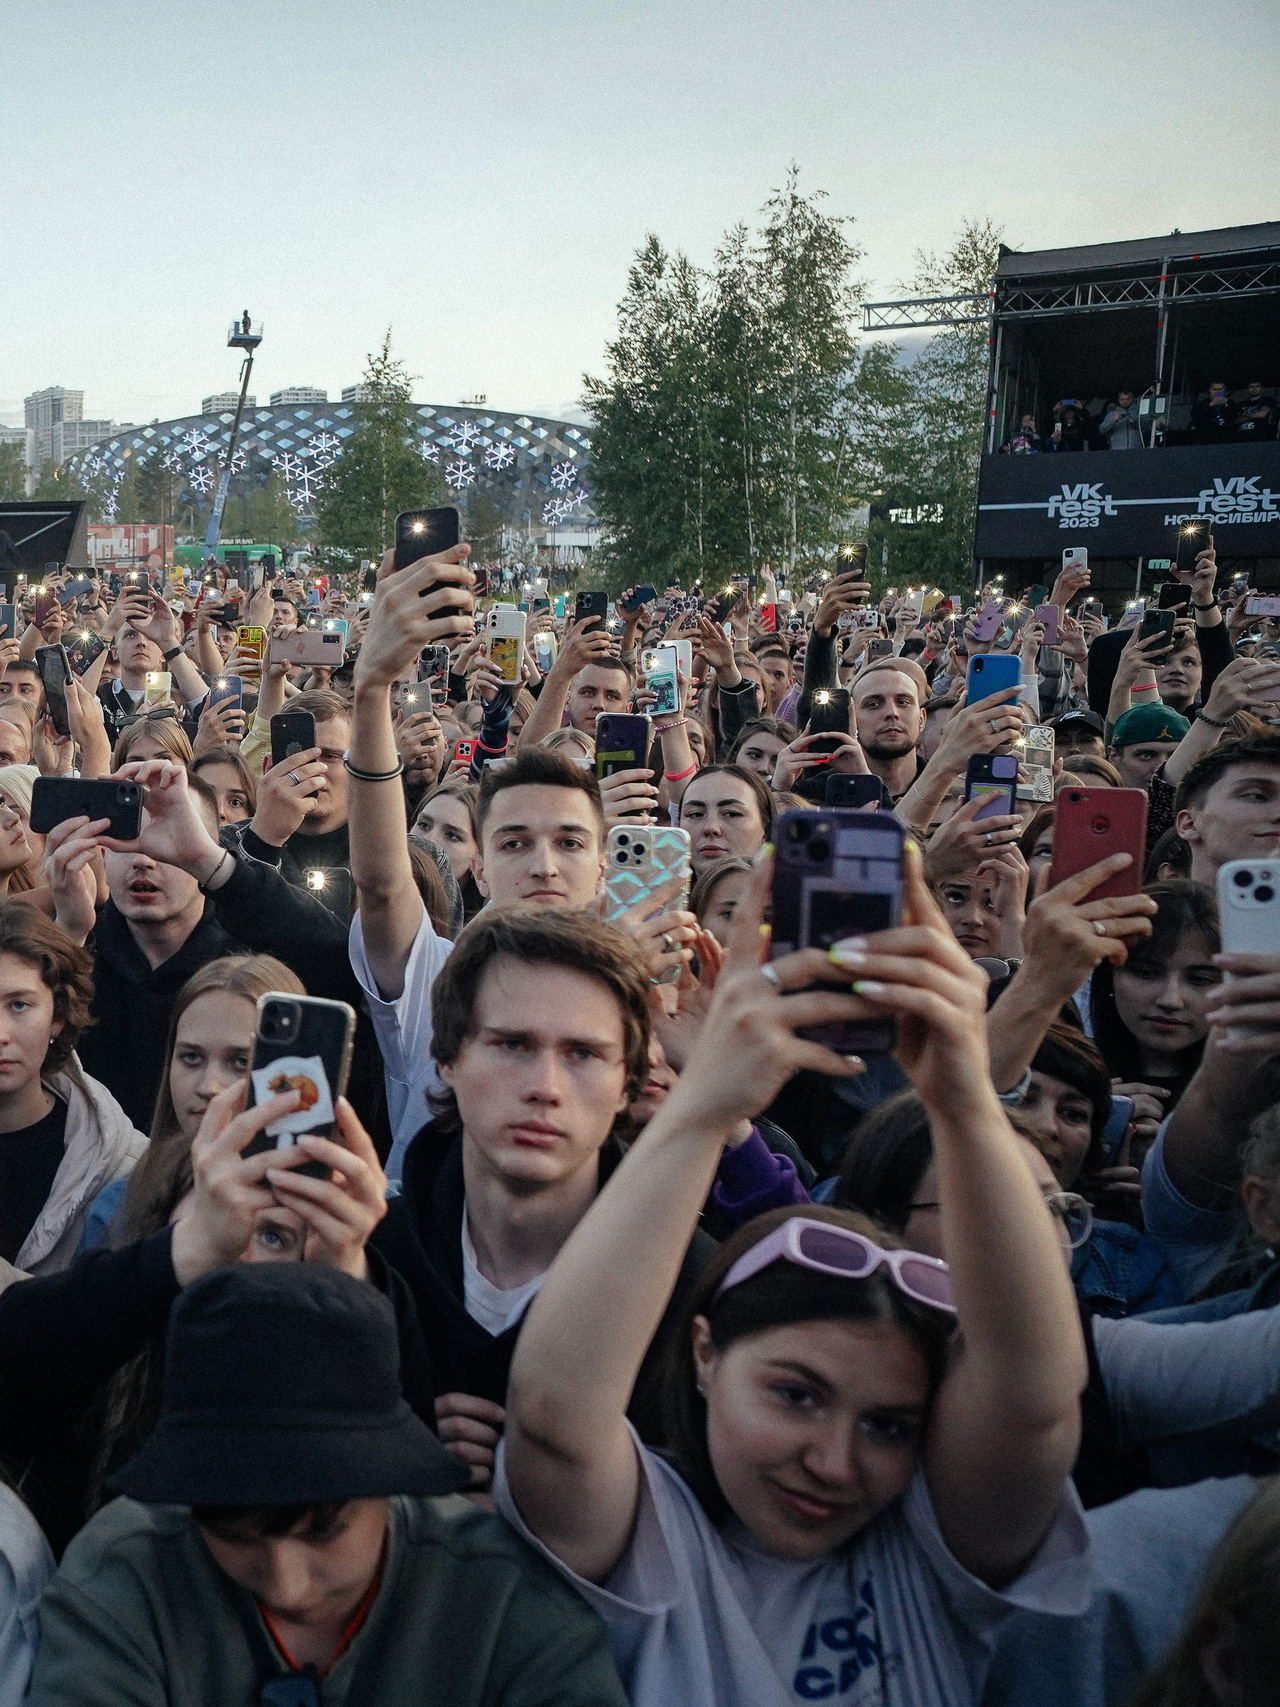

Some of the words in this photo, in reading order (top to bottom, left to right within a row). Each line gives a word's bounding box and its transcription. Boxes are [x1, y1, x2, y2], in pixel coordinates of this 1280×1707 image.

[1061, 483, 1104, 500] VK
[1213, 476, 1261, 494] VK
[1047, 495, 1118, 518] fest
[1197, 489, 1277, 513] fest
[1059, 517, 1100, 528] 2023
